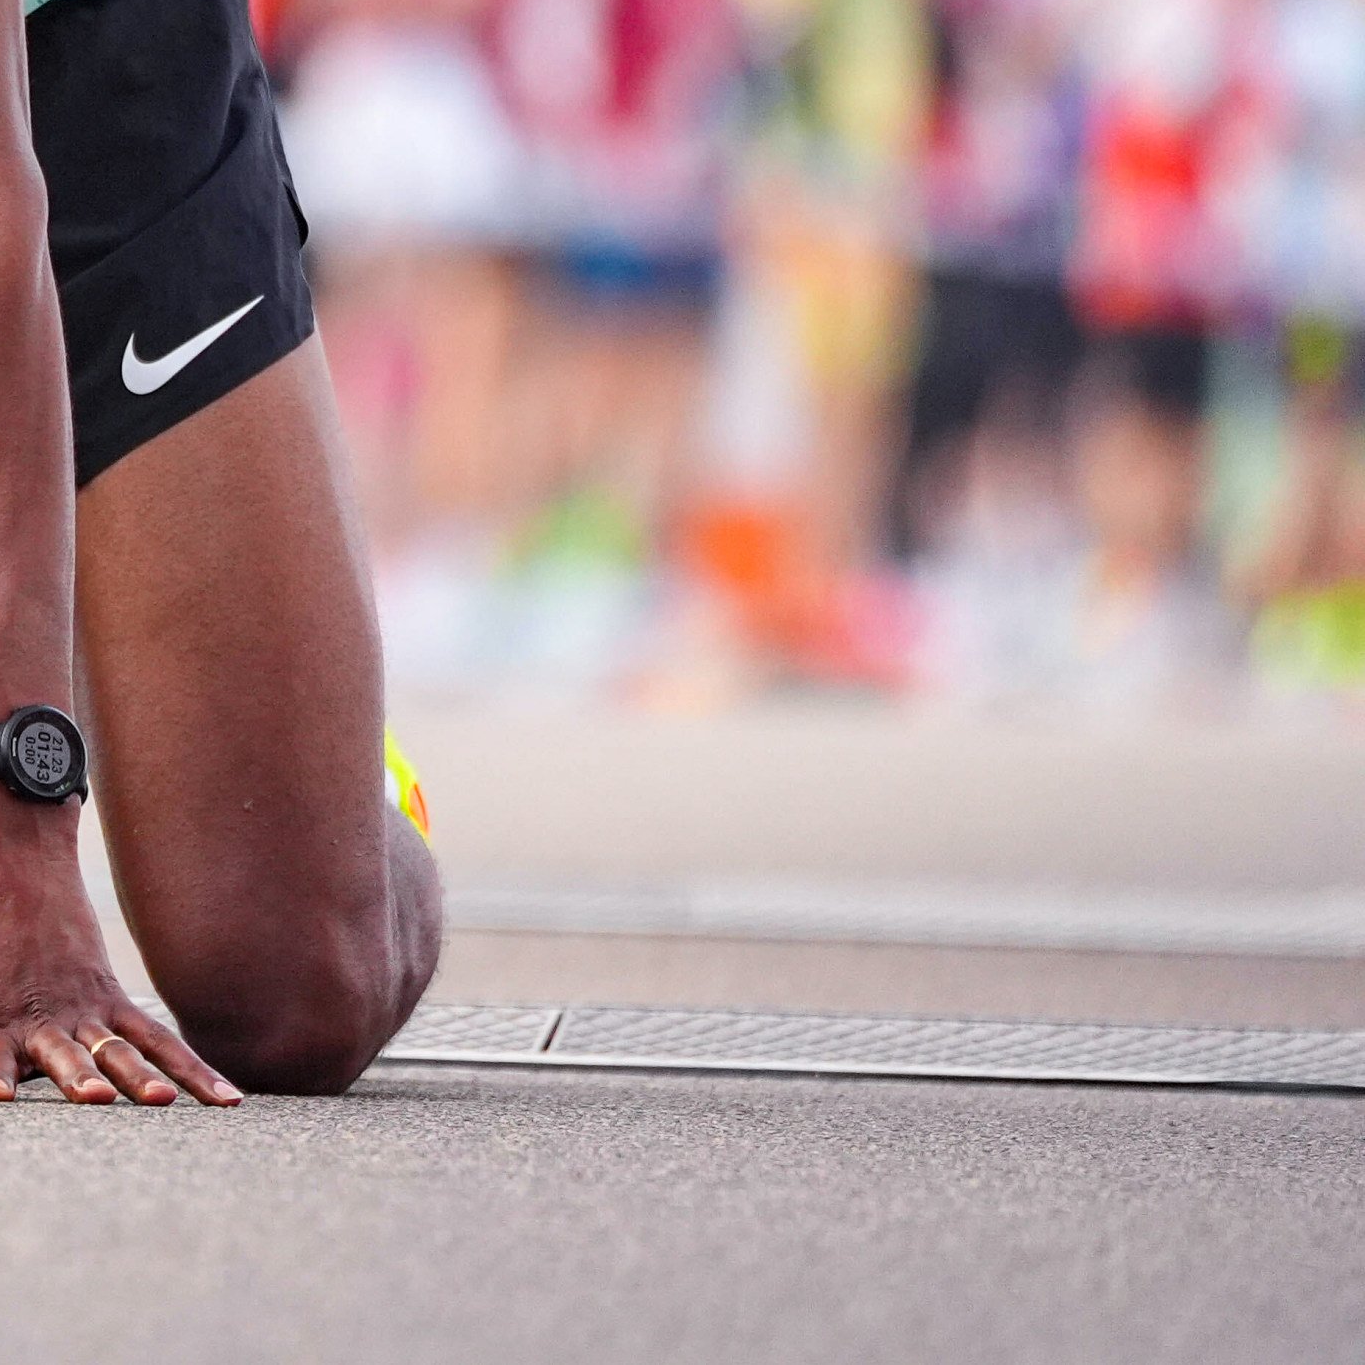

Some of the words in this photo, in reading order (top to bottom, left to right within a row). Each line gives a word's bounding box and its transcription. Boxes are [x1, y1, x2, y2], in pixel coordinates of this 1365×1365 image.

[25, 737, 36, 764] 0:00
[37, 732, 50, 782] 01:43
[52, 737, 63, 773] 21.23
